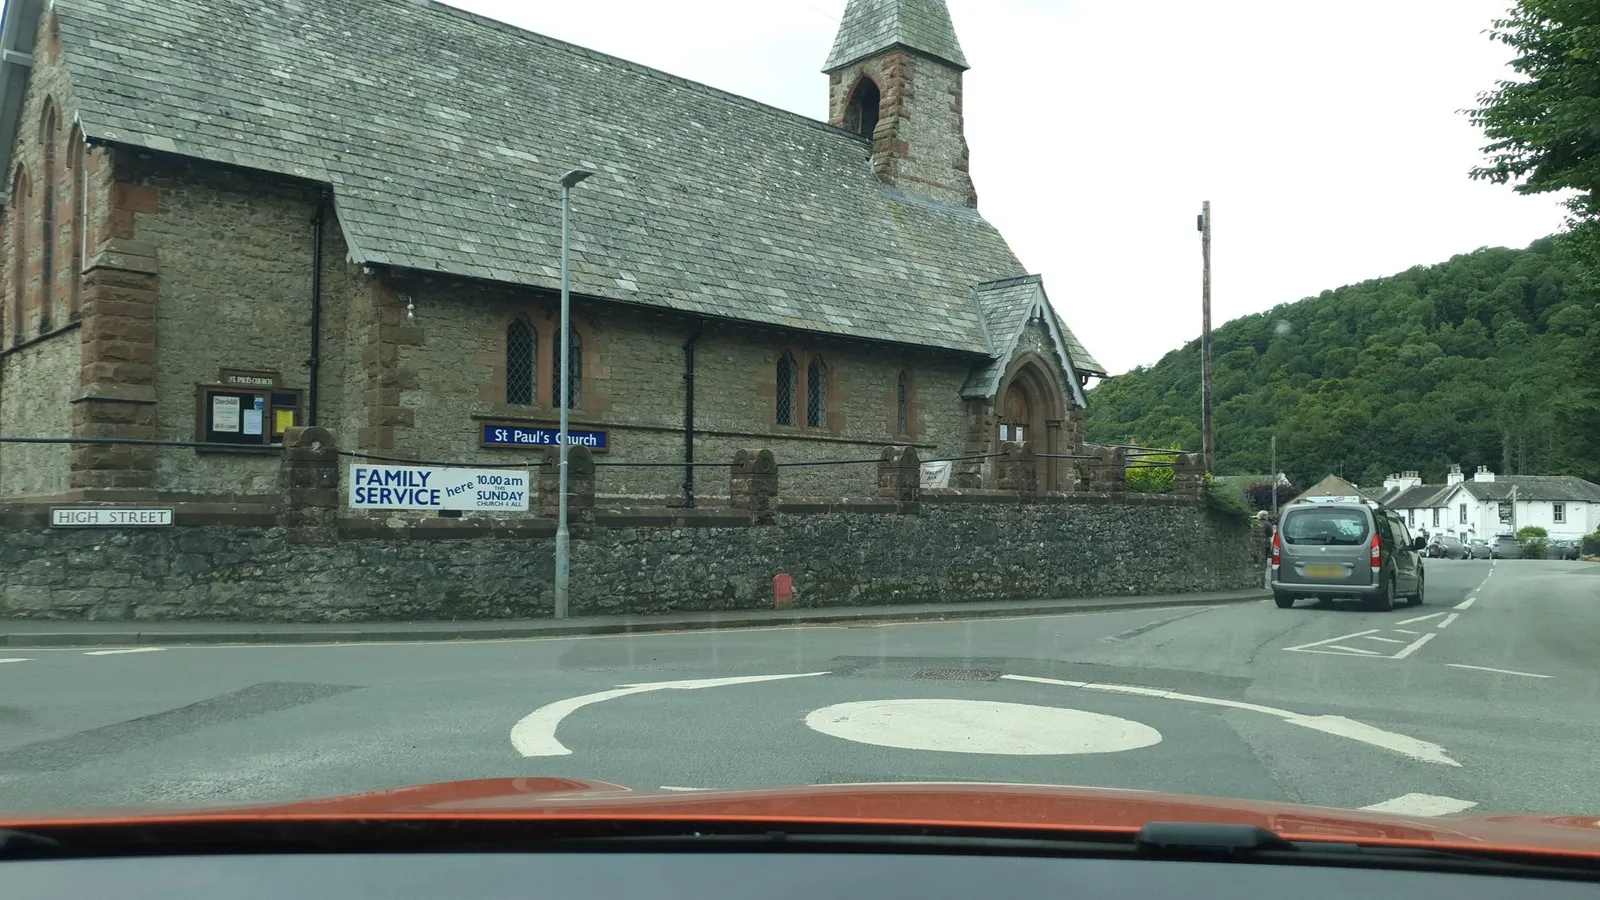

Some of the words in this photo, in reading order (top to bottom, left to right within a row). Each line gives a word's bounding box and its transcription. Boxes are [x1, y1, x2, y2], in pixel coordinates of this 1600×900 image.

[495, 429, 508, 441] St
[514, 430, 549, 443] Paul's
[355, 468, 432, 488] FAMILY
[476, 475, 502, 485] 10.00
[504, 478, 523, 486] am
[355, 487, 440, 505] SERVICE
[446, 481, 474, 498] here
[477, 490, 524, 501] SUNDAY
[58, 511, 99, 524] HIGH
[109, 511, 167, 524] STREET
